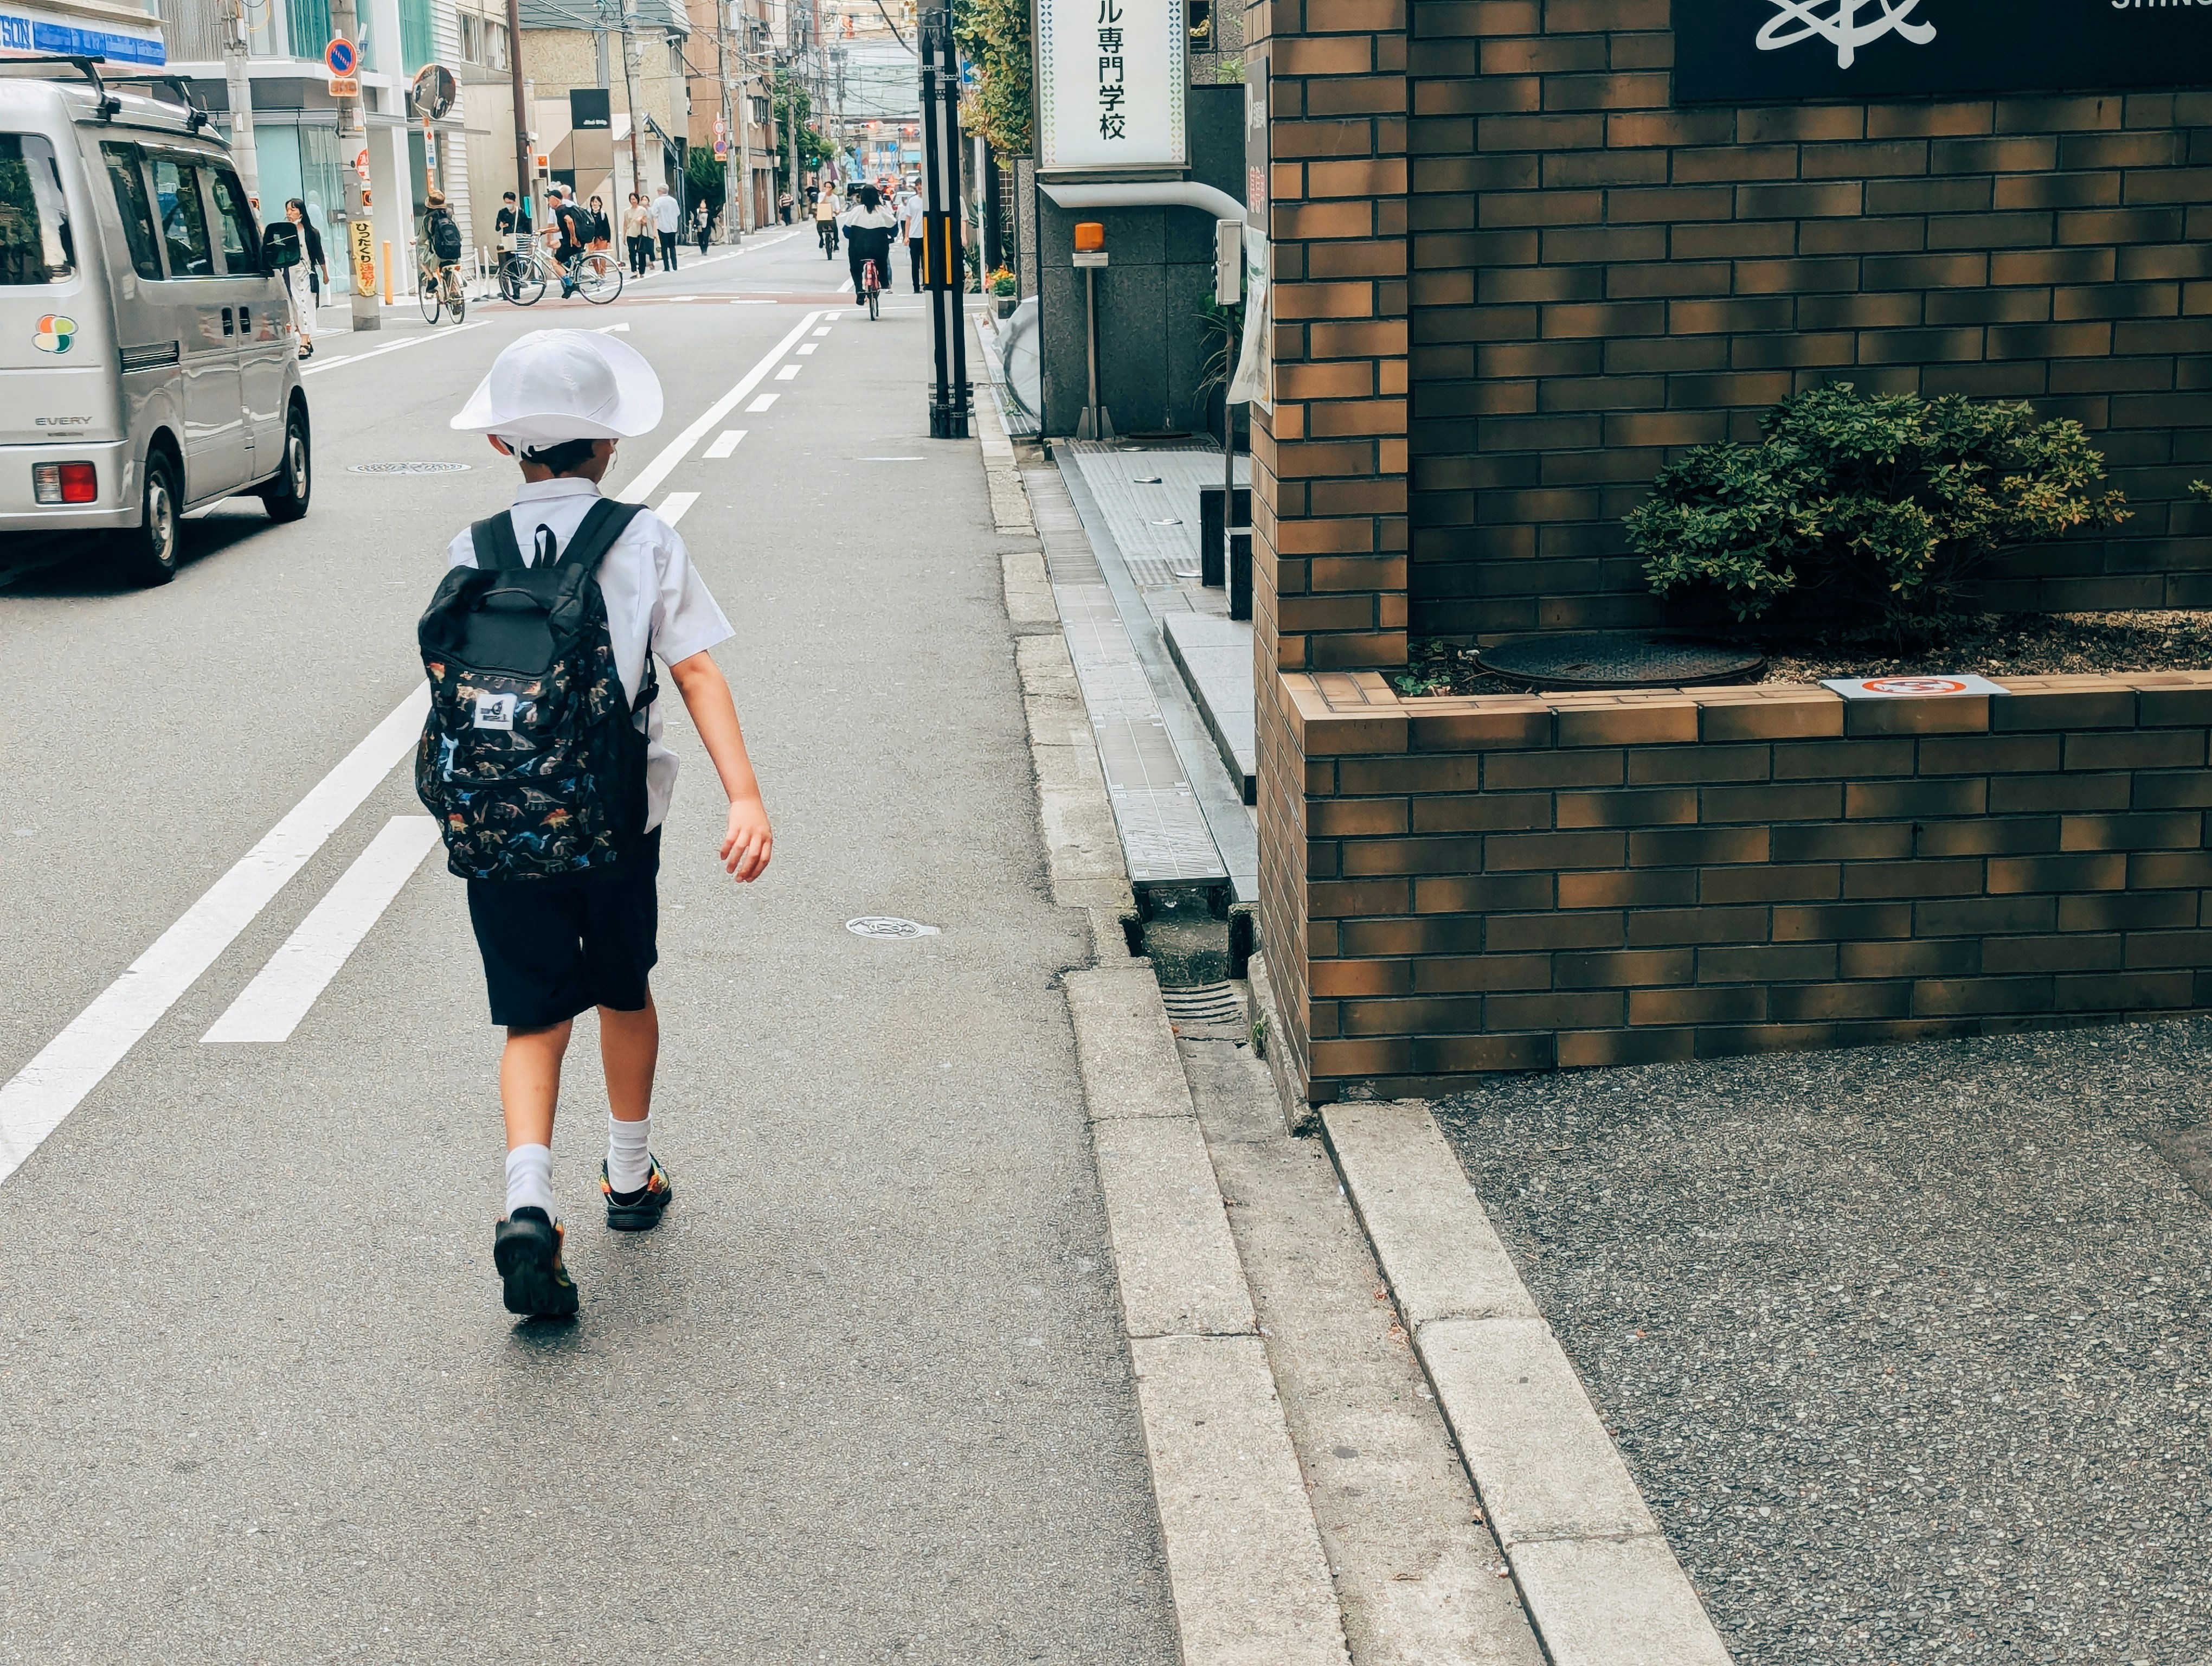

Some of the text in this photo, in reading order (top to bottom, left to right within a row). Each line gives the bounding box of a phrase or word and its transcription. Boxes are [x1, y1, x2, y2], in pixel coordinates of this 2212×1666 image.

[0, 15, 31, 50] SON
[1097, 0, 1126, 140] ル専門学校
[35, 416, 92, 425] EVERY
